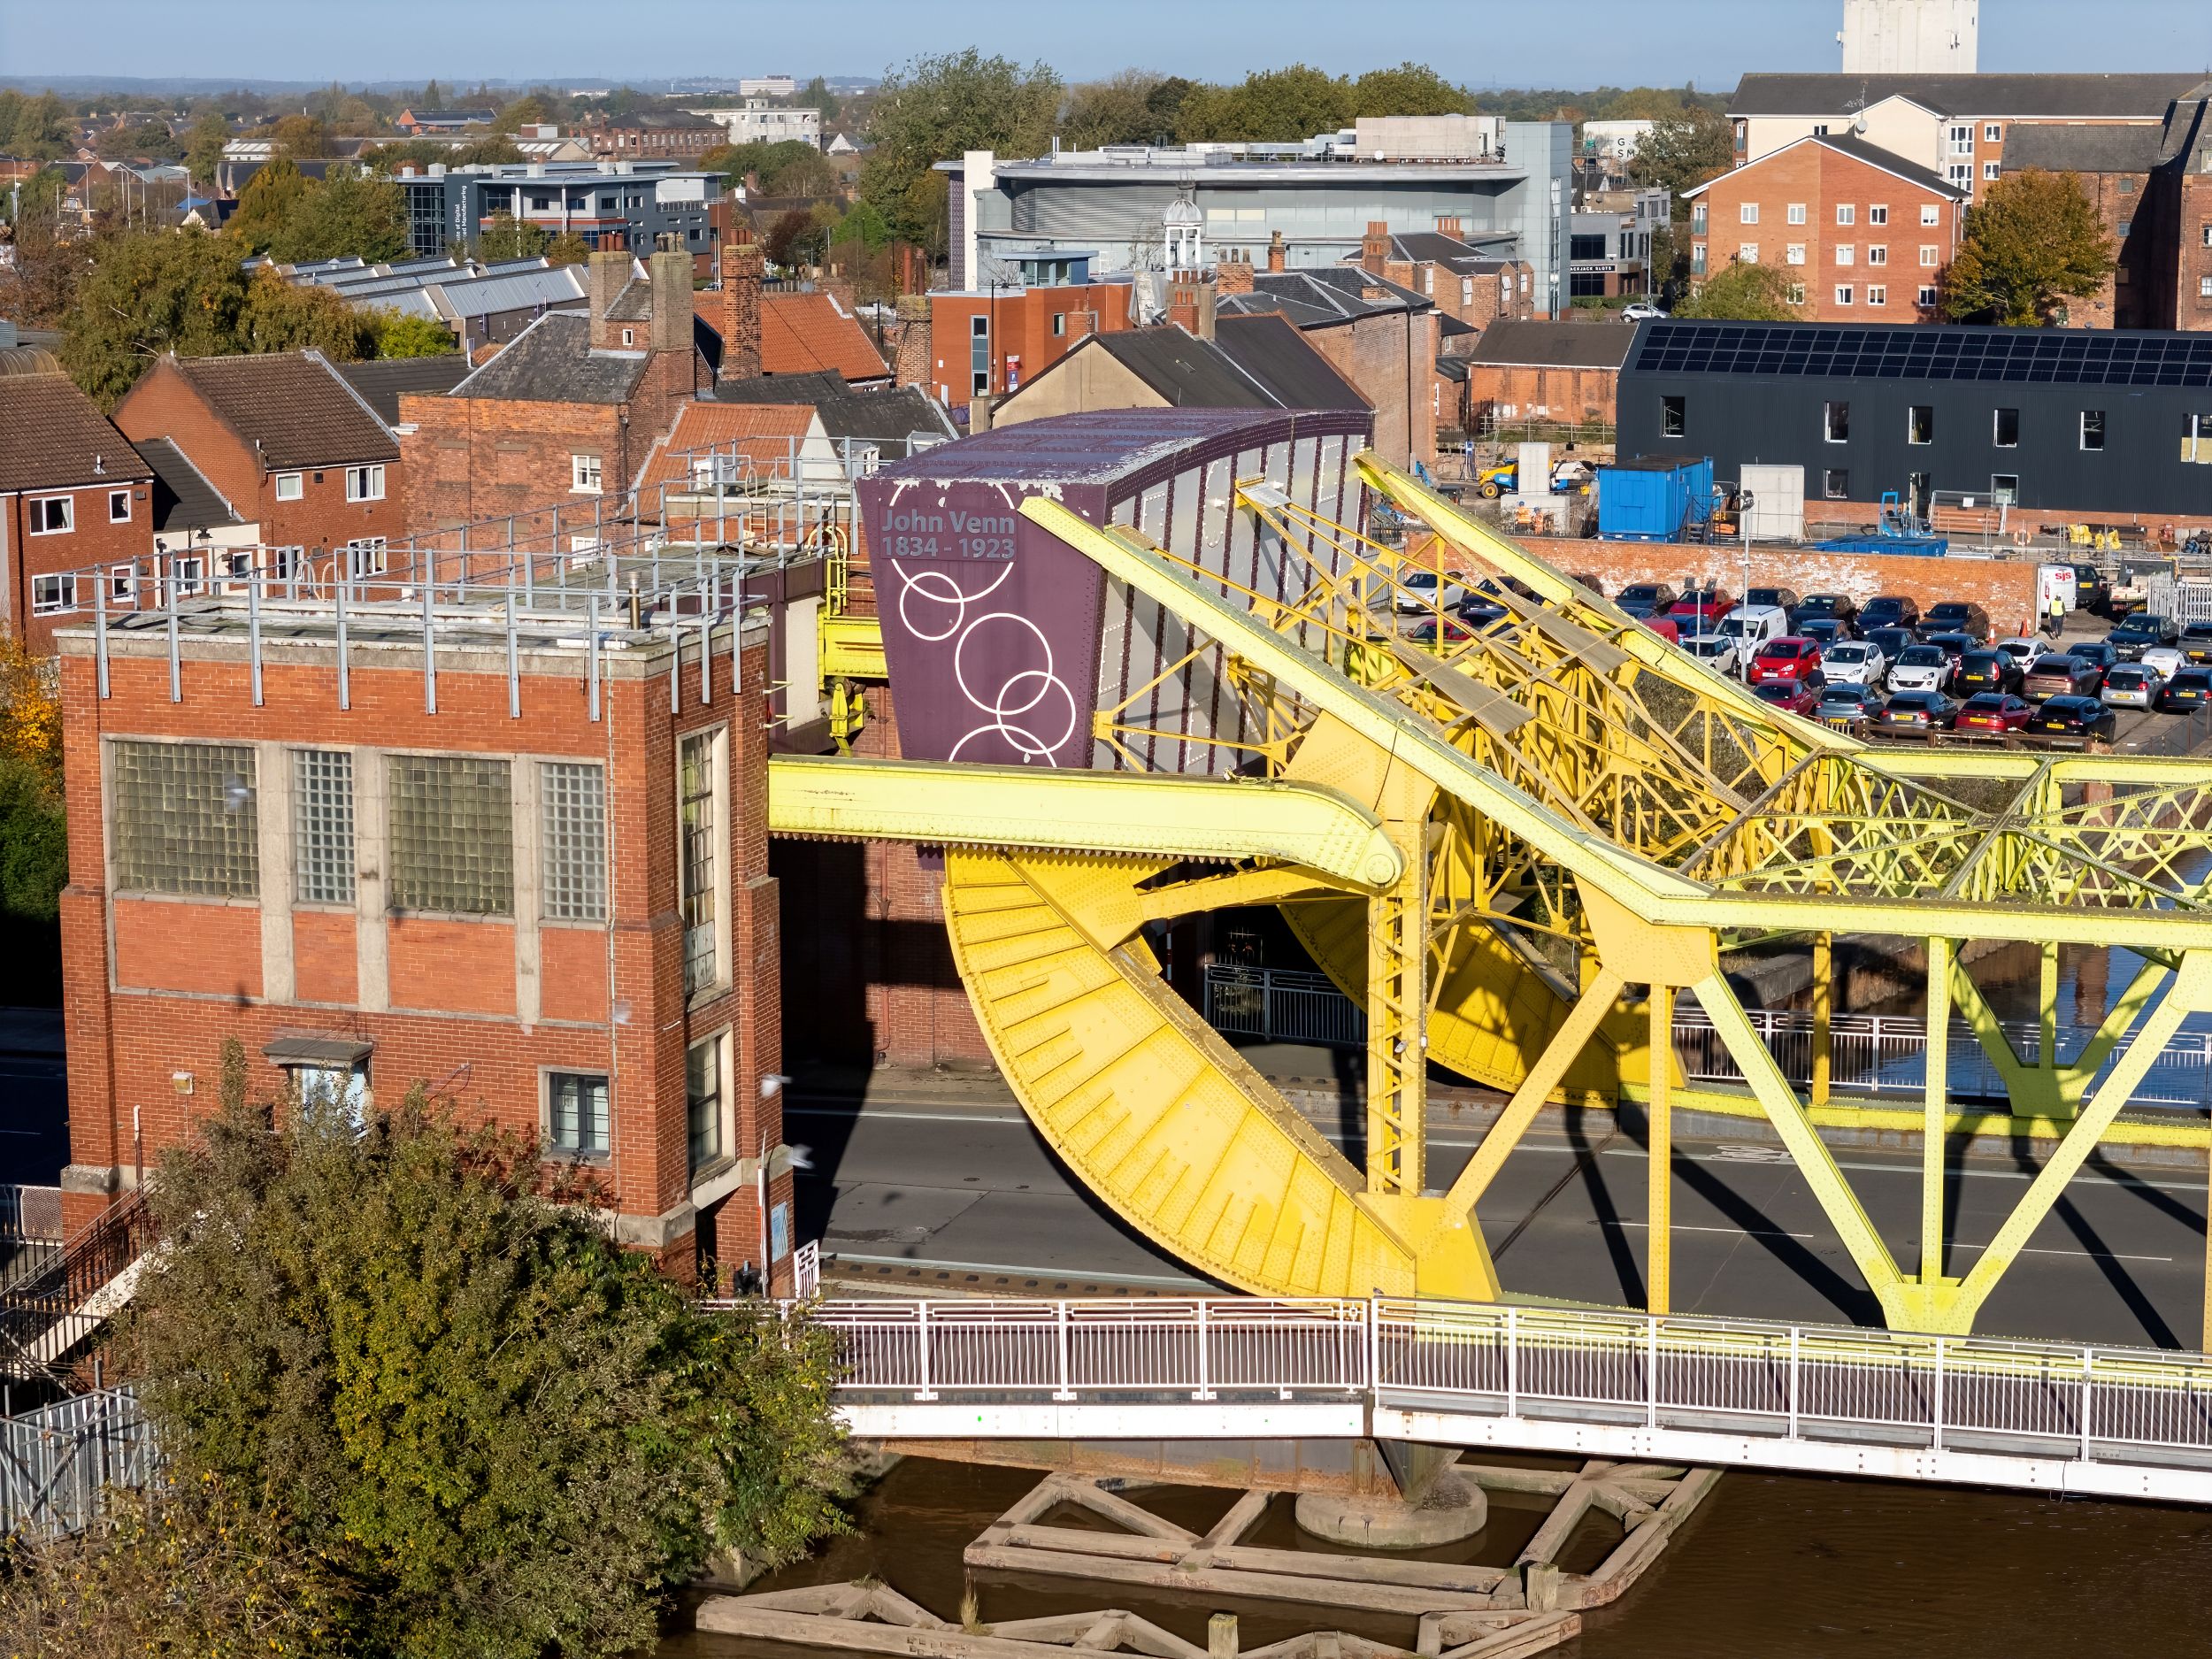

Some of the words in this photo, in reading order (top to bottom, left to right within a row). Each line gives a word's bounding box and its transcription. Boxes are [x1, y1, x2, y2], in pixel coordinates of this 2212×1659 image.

[882, 509, 943, 532] John
[949, 511, 1015, 534] Venn
[882, 536, 938, 557] 1834
[958, 538, 1016, 559] 1923
